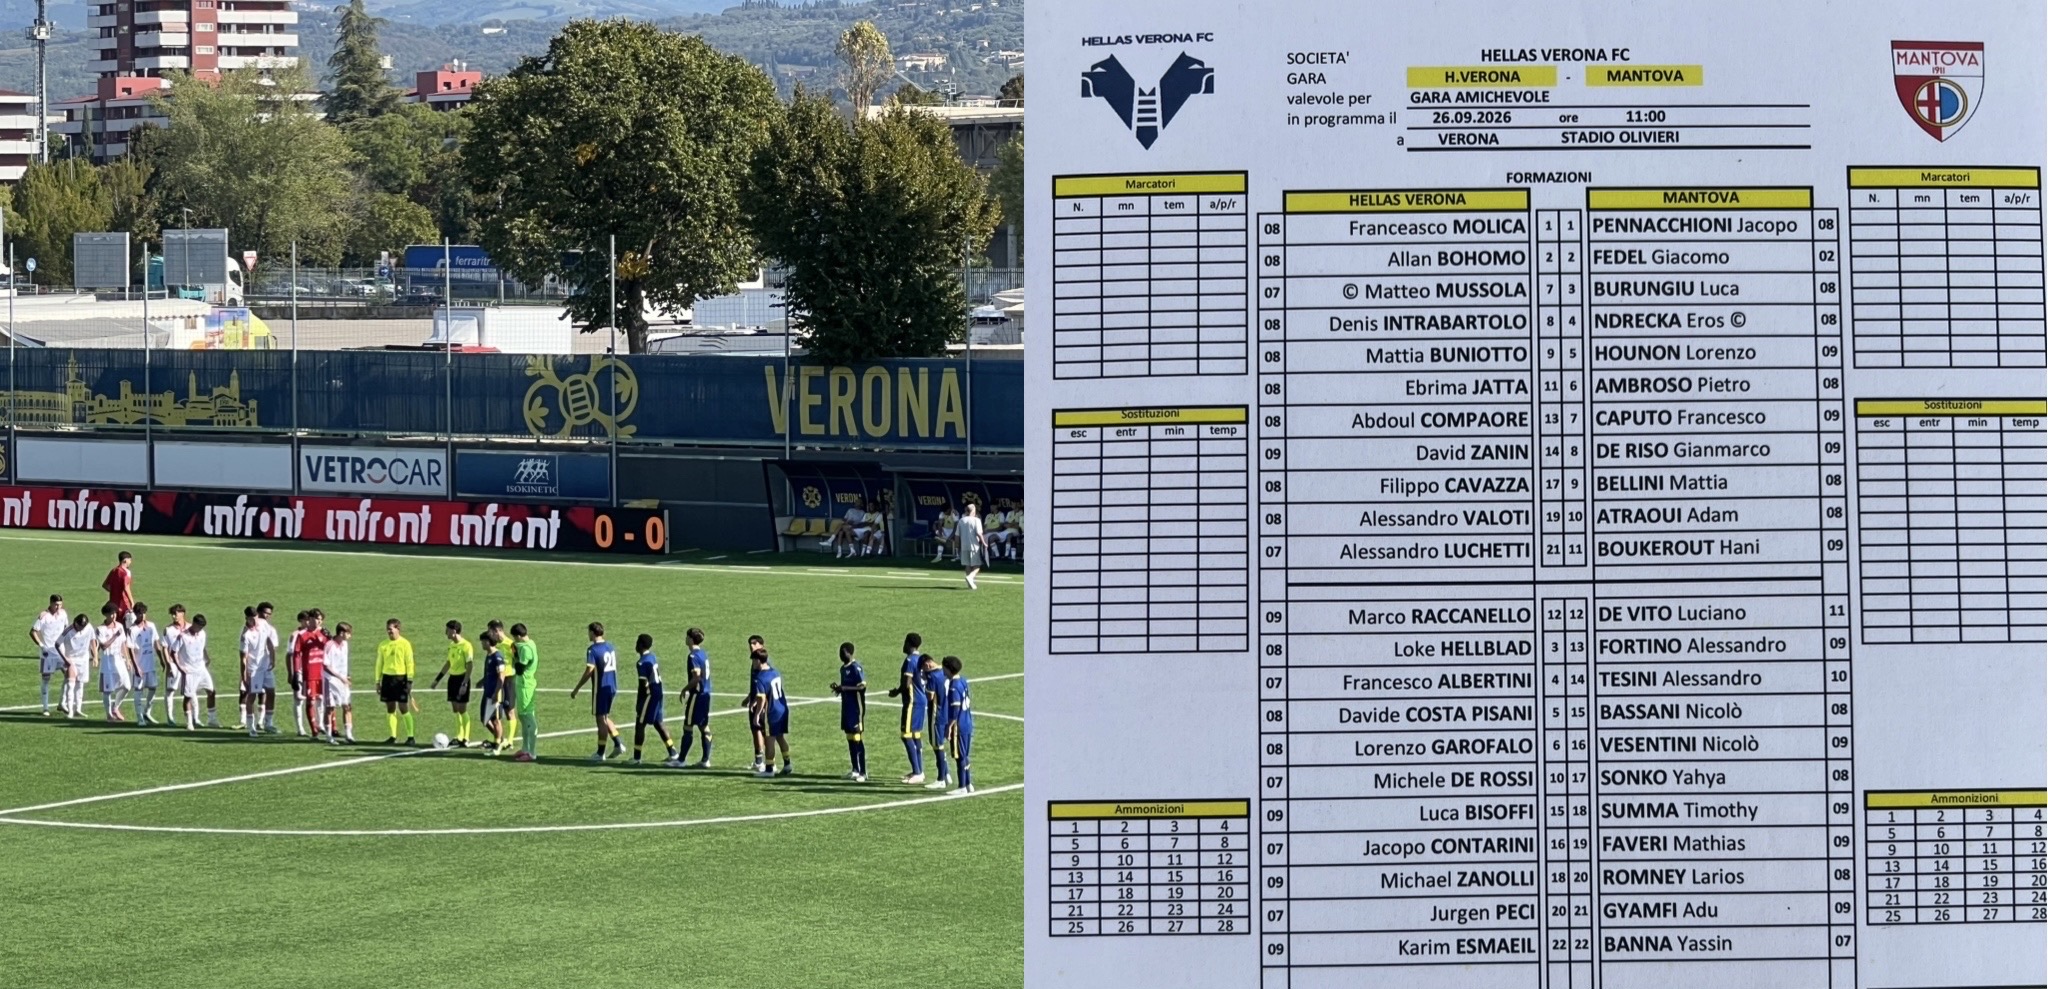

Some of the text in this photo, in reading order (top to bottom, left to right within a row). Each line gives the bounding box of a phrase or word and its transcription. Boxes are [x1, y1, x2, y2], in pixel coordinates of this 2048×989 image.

[1082, 32, 1214, 47] HELLAS VERONA FC
[1287, 51, 1349, 65] SOCIETA'
[1481, 48, 1630, 62] HELLAS VERONA FC
[1897, 51, 1979, 66] MANTOVA
[1445, 69, 1684, 83] H.VERONA MANTOVA
[1932, 66, 1945, 74] 1911
[1287, 72, 1327, 85] GARA
[1287, 92, 1372, 107] valevole per
[1410, 90, 1550, 104] GARA AMICHEVOLE
[1287, 111, 1396, 128] in programma il
[1433, 110, 1666, 124] 26.09.2026 ore 11:00
[1396, 136, 1404, 146] a
[1438, 131, 1679, 145] VERONA STADIO OLIVIERI
[1506, 171, 1592, 183] FORMAZIONI
[1921, 172, 1970, 181] Marcatori
[1126, 179, 1175, 189] Marcatori
[1350, 193, 1466, 206] HELLAS VERONA
[1663, 191, 1740, 203] MANTOVA
[1869, 194, 1880, 202] N.
[1960, 194, 1980, 203] tem
[2004, 193, 2030, 205] a/p/r
[1073, 203, 1083, 212] N.
[1164, 201, 1184, 209] tem
[1210, 199, 1236, 211] a/p/r
[1264, 223, 1280, 235] 08
[1350, 219, 1526, 236] Franceasco MOLICA
[1568, 220, 1574, 230] 1
[1593, 218, 1797, 236] PENNACCHIONI Jacopo
[1388, 250, 1526, 267] Allan BOHOMO
[1594, 249, 1729, 265] FEDEL Giacomo
[1819, 250, 1835, 262] 02
[1366, 284, 1430, 299] Matteo
[1436, 282, 1527, 298] MUSSOLA
[1594, 281, 1739, 296] BURUNGIU Luca
[1330, 314, 1527, 332] Denis INTRABARTOLO
[1595, 313, 1682, 328] NDRECKA
[1687, 313, 1724, 328] Eros
[1595, 345, 1756, 361] HOUNON Lorenzo
[1406, 379, 1528, 396] Ebrima JATTA
[1595, 377, 1751, 393] AMBROSO Pietro
[765, 365, 966, 439] VERONA
[1923, 400, 1983, 411] Sostituzioni
[1120, 408, 1180, 420] Sostituzioni
[1351, 412, 1528, 429] Abdoul COMPAORE
[1545, 413, 1559, 424] 13
[1596, 409, 1766, 426] CAPUTO Francesco
[1919, 419, 1940, 427] entr
[1968, 417, 1988, 428] min
[2012, 418, 2039, 429] temp
[1071, 430, 1086, 438] esc
[1116, 428, 1136, 437] entr
[1165, 426, 1184, 435] min
[1210, 426, 1237, 436] temp
[1597, 442, 1771, 459] DE RISO Gianmarco
[305, 455, 442, 486] VETROCAR
[506, 485, 558, 494] ISOKINETIC
[47, 489, 144, 531] infront
[204, 494, 305, 539] infront
[325, 498, 431, 544] infront
[450, 503, 561, 549] infront
[1597, 506, 1738, 524] ATRAOUI Adam
[595, 514, 614, 548] 0
[645, 516, 665, 550] 0
[1265, 546, 1282, 558] 07
[1340, 542, 1530, 559] Alessandro LUCHETTI
[1569, 544, 1582, 554] 11
[1598, 539, 1760, 557] BOUKEROUT Hani
[1349, 607, 1531, 625] Marco RACCANELLO
[1599, 605, 1746, 622] DE VITO Luciano
[1343, 673, 1531, 690] Francesco ALBERTINI
[1598, 669, 1762, 687] TESINI Alessandro
[1831, 670, 1847, 682] 10
[1339, 705, 1532, 724] Davide COSTA PISANI
[1355, 738, 1533, 756] Lorenzo GAROFALO
[1600, 735, 1759, 752] VESENTINI Nicolò
[1374, 771, 1533, 789] Michele DE ROSSI
[1601, 768, 1726, 789] SONKO Yahya
[1931, 793, 1998, 803] Ammonizioni
[1115, 804, 1184, 814] Ammonizioni
[1888, 827, 1896, 839] 5
[1363, 837, 1533, 859] Jacopo CONTARINI
[1603, 834, 1746, 852] FAVERI Mathias
[1068, 871, 1083, 883] 13
[1381, 870, 1534, 889] Michael ZANOLLI
[1430, 904, 1535, 925] Jurgen PECI
[1603, 901, 1718, 919] GYAMFI Adu
[1399, 938, 1536, 956] Karim ESMAEIL
[1575, 939, 1589, 950] 22
[1605, 935, 1732, 952] BANNA Yassin
